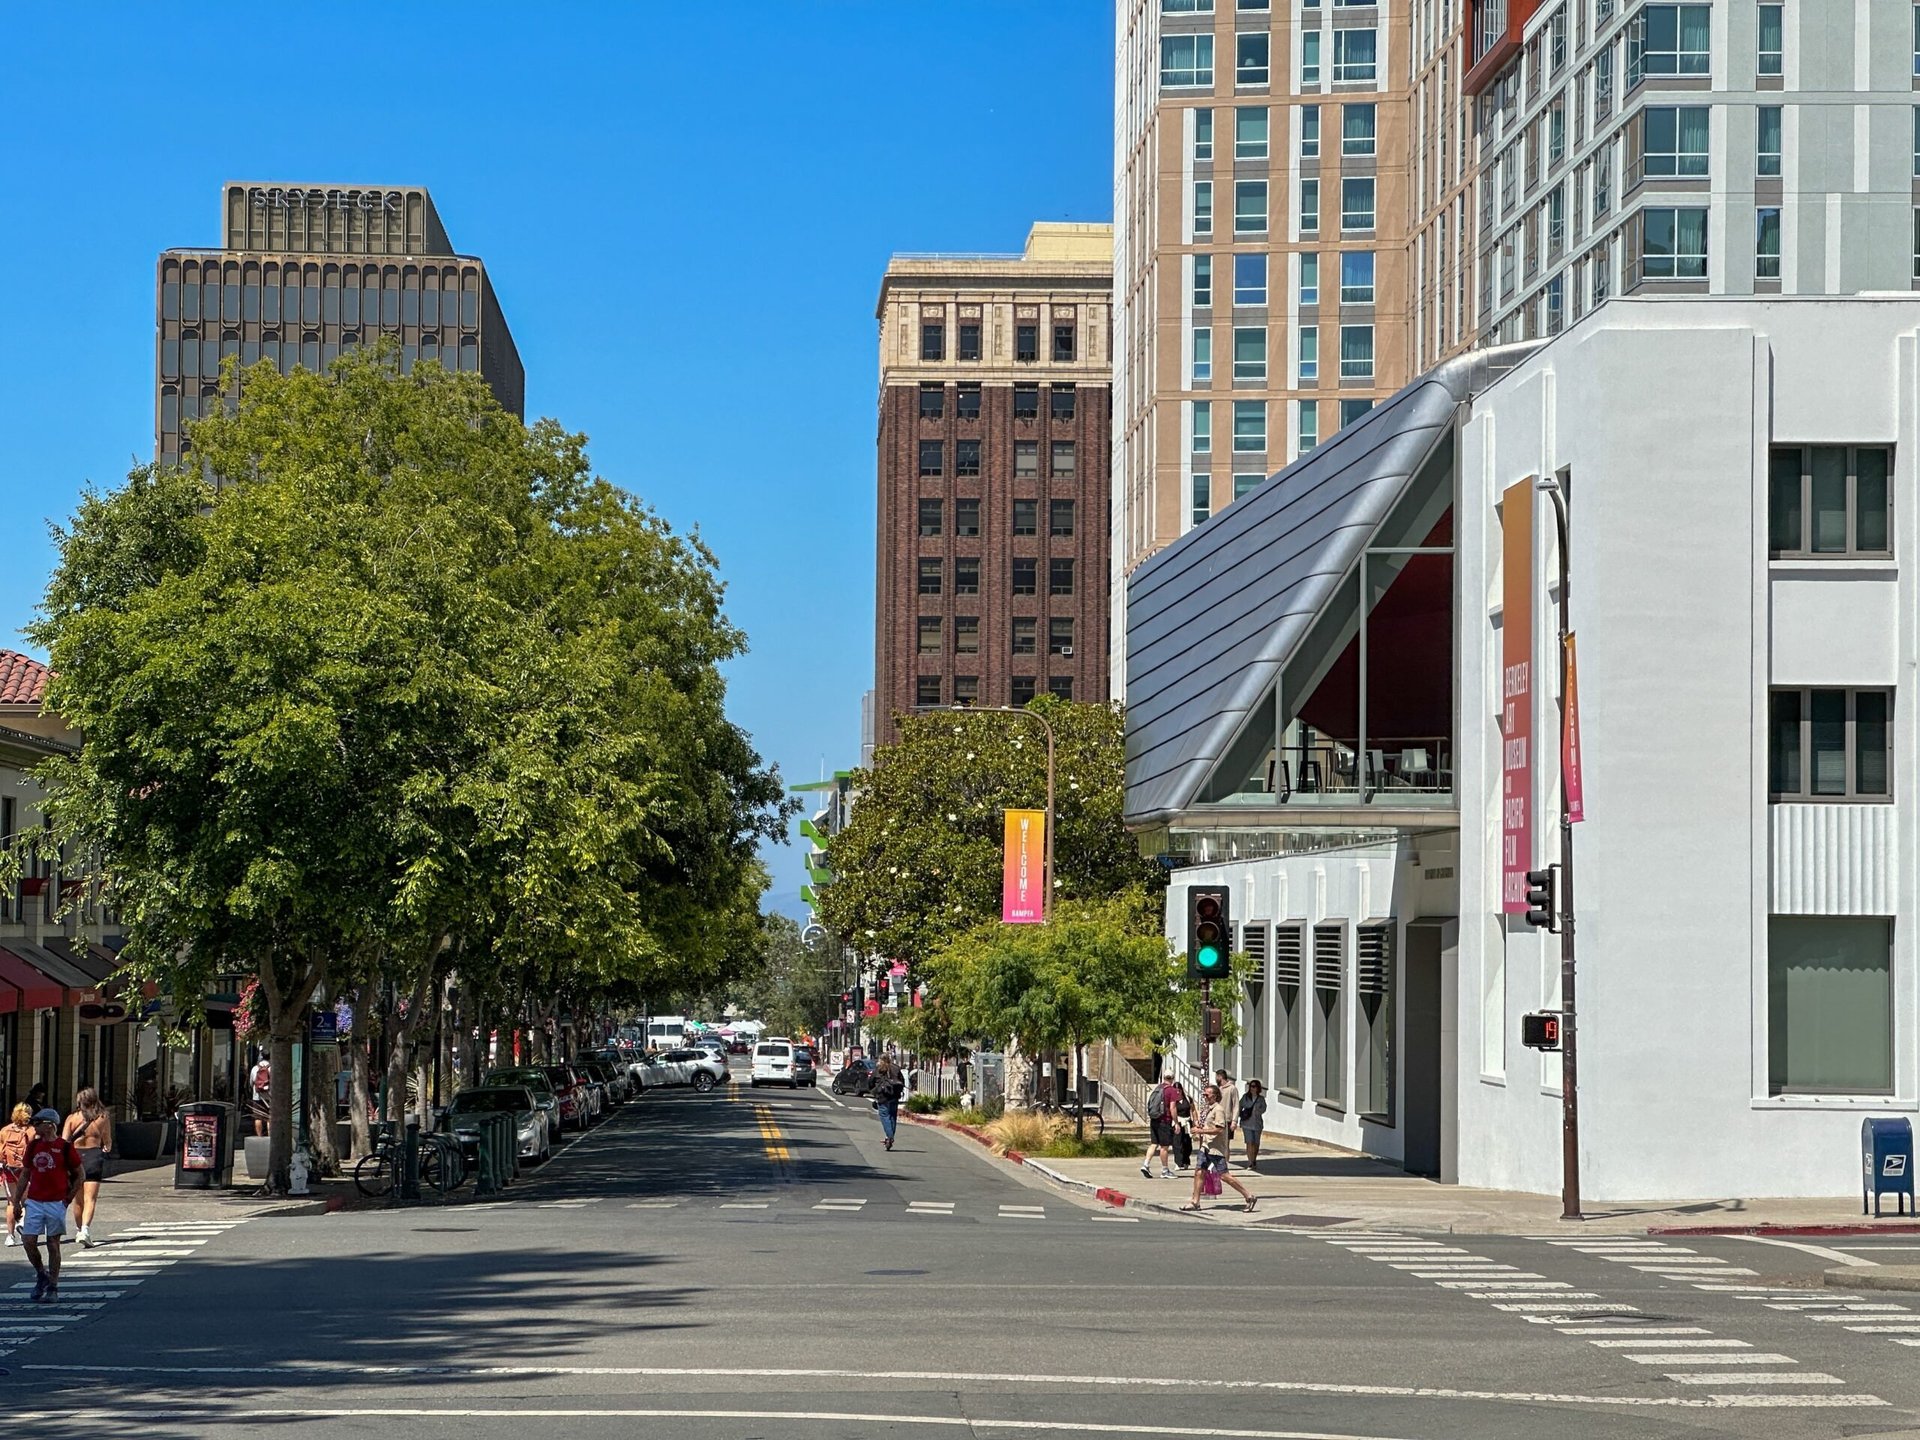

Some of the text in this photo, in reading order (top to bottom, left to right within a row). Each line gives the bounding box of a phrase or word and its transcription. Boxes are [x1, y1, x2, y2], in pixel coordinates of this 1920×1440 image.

[1505, 661, 1529, 698] BERKELEY
[1505, 702, 1515, 734] ART
[1505, 736, 1527, 771] MUSEUM
[1505, 797, 1524, 829] PACIFIC
[1019, 818, 1029, 902] WELCOME
[1505, 834, 1517, 866] FILM
[1504, 871, 1526, 902] ARCHIVE
[1011, 909, 1034, 917] BAMPFA
[1545, 1020, 1557, 1039] 19
